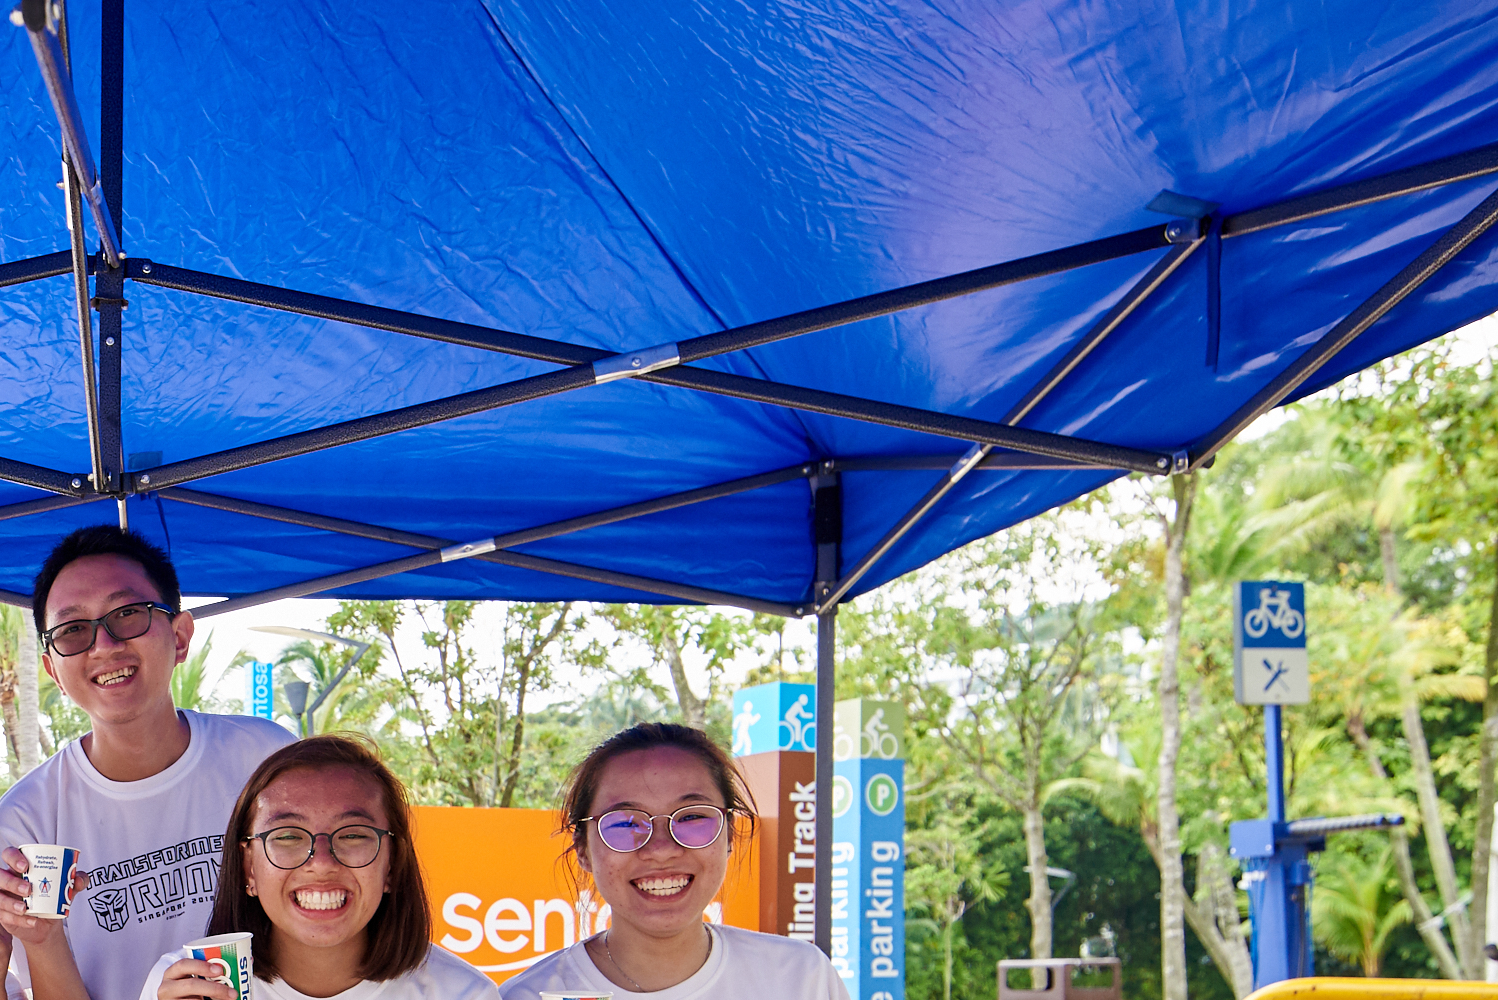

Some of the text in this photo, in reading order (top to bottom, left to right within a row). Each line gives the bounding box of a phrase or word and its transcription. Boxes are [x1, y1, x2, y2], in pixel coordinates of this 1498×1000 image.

[255, 662, 268, 718] ntosa
[87, 835, 224, 890] TRANSFORME
[129, 861, 212, 914] RUN
[788, 781, 816, 943] ling Track
[138, 902, 186, 923] SINGAPORE
[440, 890, 722, 953] sent
[865, 840, 900, 978] parking
